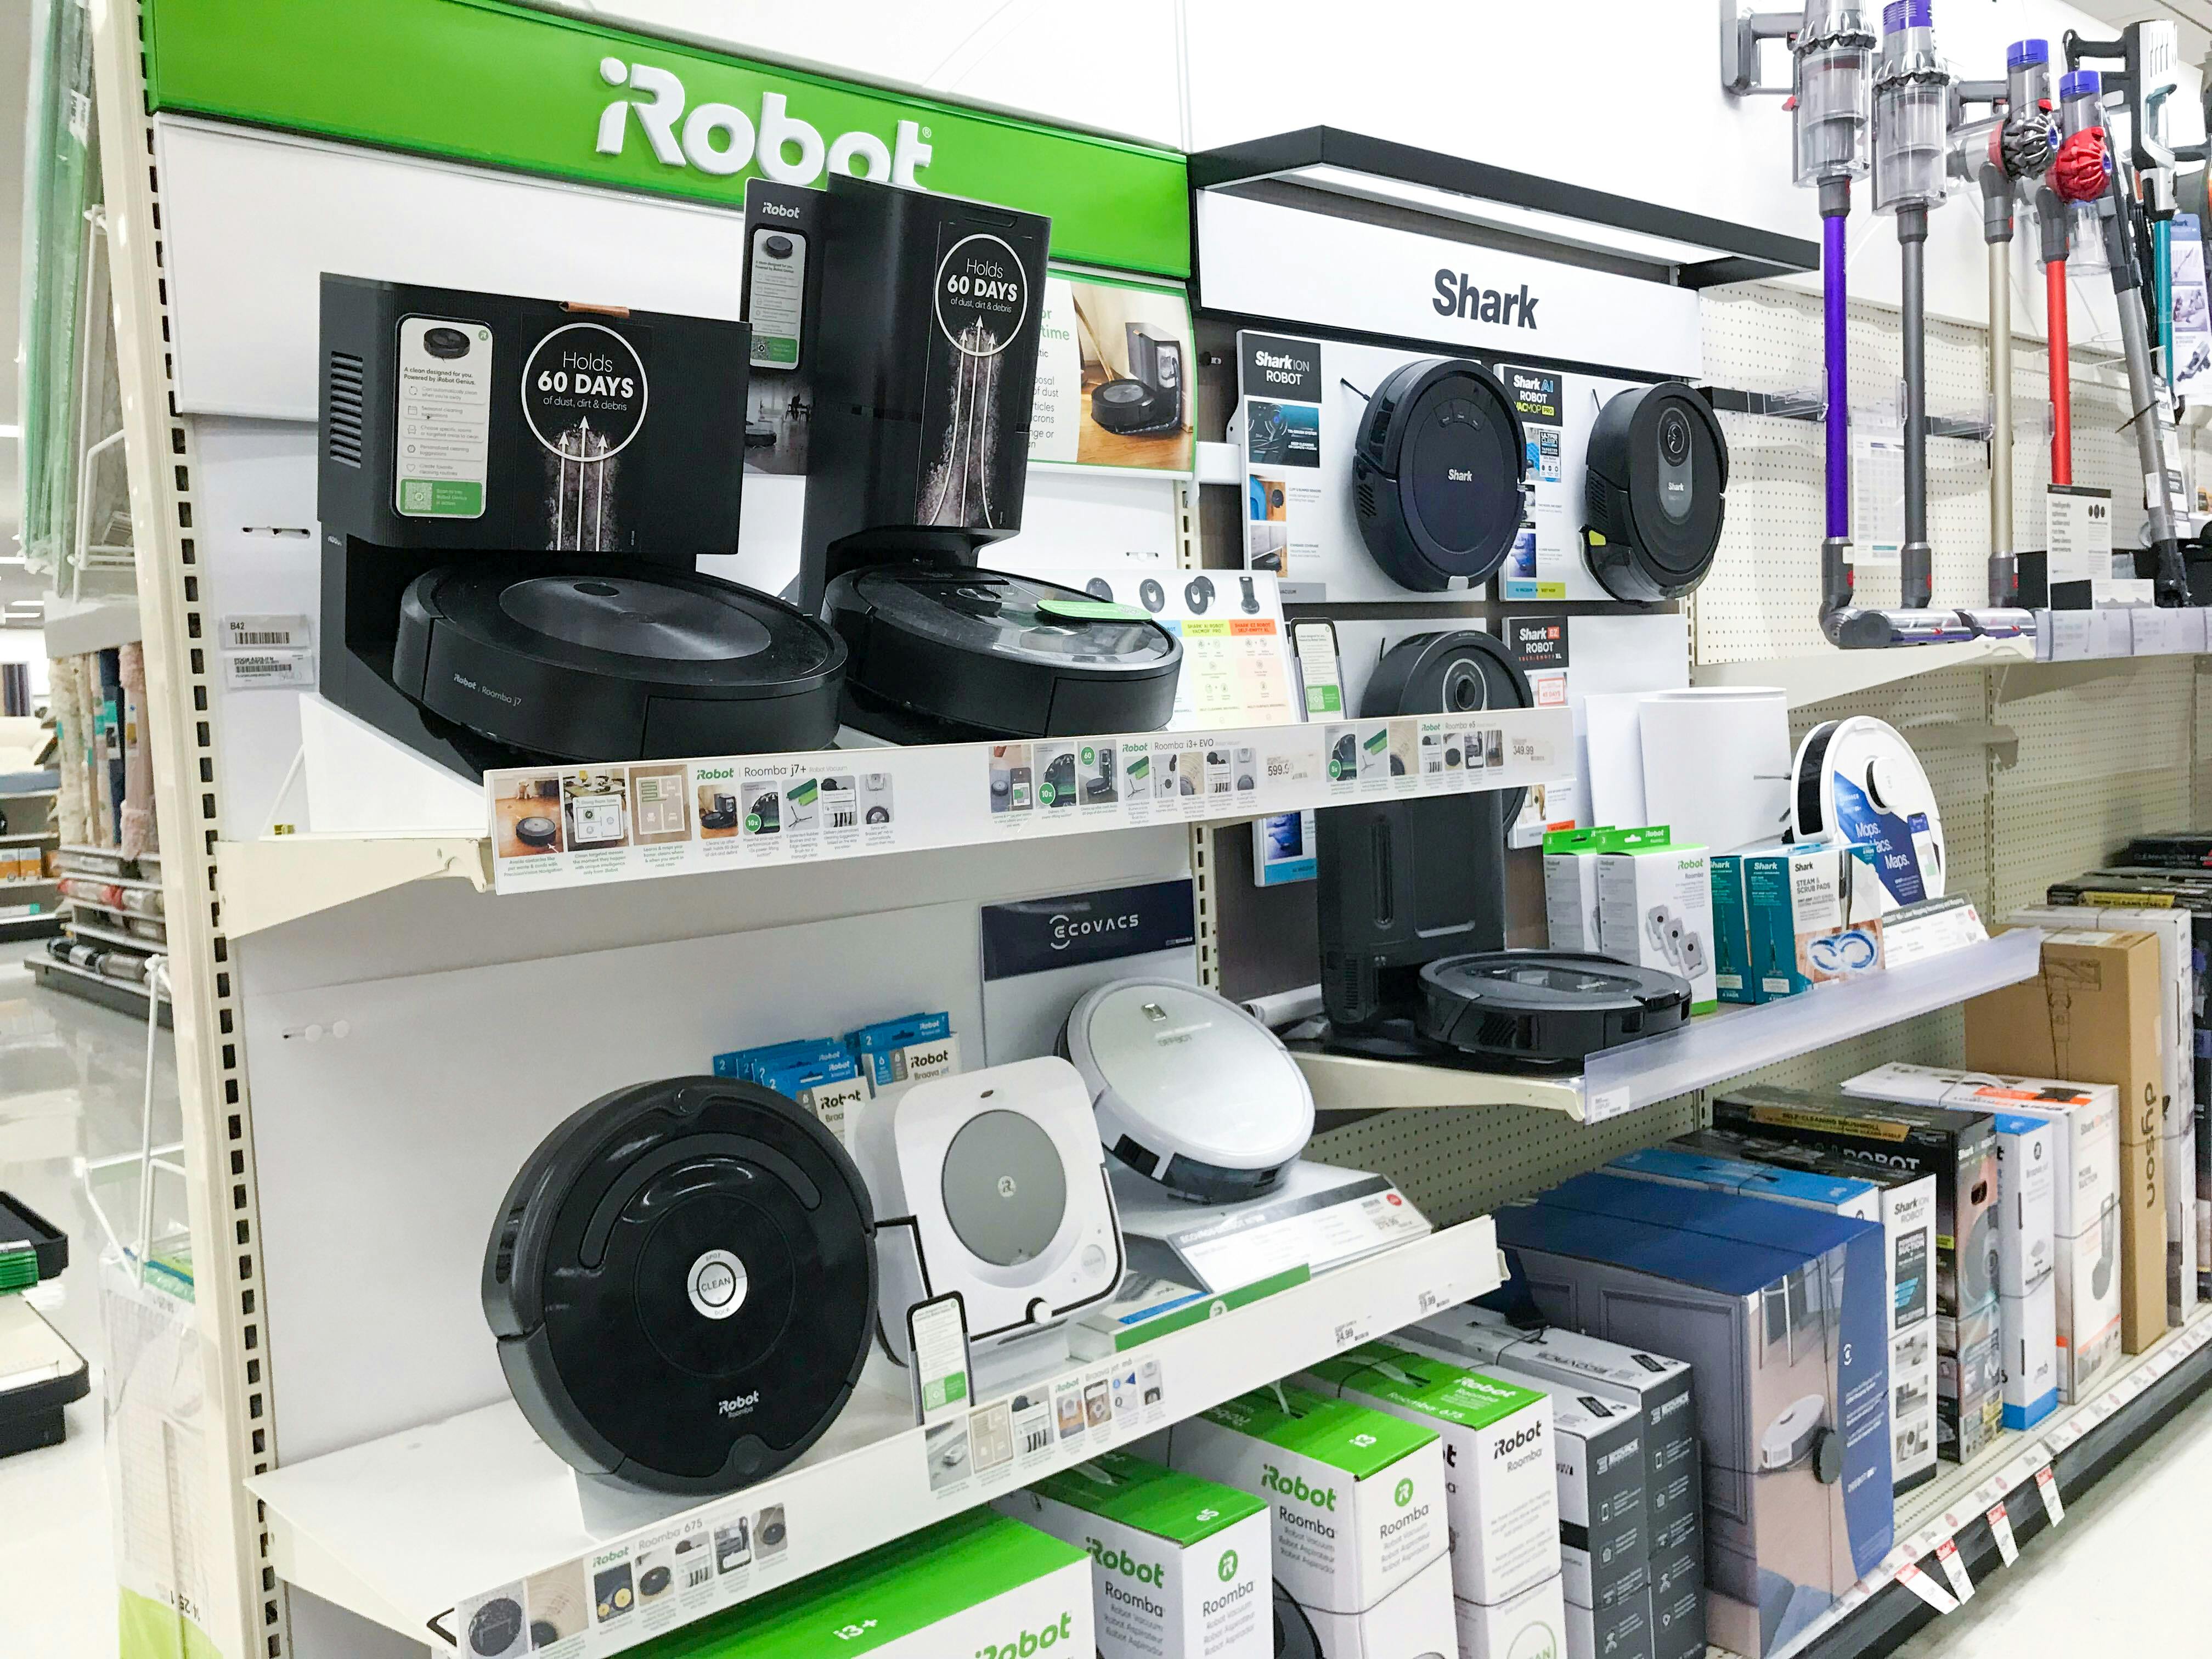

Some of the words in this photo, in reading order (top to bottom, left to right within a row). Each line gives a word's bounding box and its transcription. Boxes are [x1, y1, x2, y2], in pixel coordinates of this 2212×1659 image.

[596, 57, 932, 189] iRobot
[763, 202, 800, 219] iRobot
[967, 258, 1003, 278] Holds
[947, 274, 969, 295] 60
[974, 278, 1018, 302] DAYS
[958, 298, 974, 308] dust,
[975, 301, 986, 309] dirt
[986, 302, 991, 310] &
[992, 303, 1012, 313] debris
[1432, 269, 1539, 329] Shark
[1041, 325, 1070, 340] time
[563, 351, 613, 373] Holds
[1255, 351, 1293, 370] Shark
[1293, 360, 1310, 372] ION
[538, 370, 568, 392] 60
[575, 373, 634, 398] DAYS
[1266, 370, 1302, 385] ROBOT
[1514, 375, 1541, 391] Shark
[1541, 379, 1554, 392] AI
[1042, 387, 1059, 397] dust
[1520, 391, 1547, 404] ROBOT
[543, 396, 553, 405] of
[554, 397, 575, 408] dust,
[577, 399, 591, 408] dirt
[592, 399, 599, 409] &
[601, 400, 627, 411] debris
[1046, 431, 1054, 439] or
[1448, 469, 1472, 482] Shark
[1668, 482, 1684, 492] Shark
[230, 622, 245, 630] B42
[1519, 627, 1547, 641] Shark
[1526, 641, 1554, 653] ROBOT
[454, 673, 477, 690] iRobot
[482, 686, 512, 703] Roomba
[513, 697, 522, 707] j7
[1421, 723, 1441, 731] iRobot
[1445, 721, 1468, 730] Roomba
[1122, 742, 1148, 753] iRobot
[1154, 741, 1184, 751] Roomba
[1186, 740, 1198, 748] i3+
[1199, 738, 1214, 747] EVO
[1513, 746, 1534, 755] 349.99
[1084, 751, 1092, 759] 60
[696, 768, 734, 780] iRobot
[744, 765, 787, 777] Roomba
[790, 764, 806, 777] j7+
[1041, 789, 1053, 798] 10x
[1855, 822, 1881, 838] Mops.
[1678, 858, 1703, 870] iRobot
[1754, 862, 1778, 870] Shark
[1795, 862, 1813, 872] Shark
[1884, 854, 1910, 870] Maps.
[1796, 878, 1815, 887] STEAM
[1797, 884, 1815, 894] SCRUB
[1817, 882, 1831, 890] PADS
[1054, 914, 1139, 939] ECOVACS
[919, 1020, 939, 1030] iRobot
[866, 1036, 872, 1046] 2
[819, 1051, 840, 1062] iRobot
[911, 1050, 949, 1069] iRobot
[719, 1060, 726, 1070] 2
[828, 1060, 850, 1071] iRobot
[914, 1069, 939, 1080] Braava
[825, 1112, 844, 1122] Braa
[2141, 1082, 2157, 1209] dyson
[1894, 1198, 1918, 1215] Shark
[701, 1277, 731, 1293] CLEAN
[1453, 1376, 1517, 1397] iRobot
[719, 1390, 759, 1415] iRobot
[1493, 1420, 1542, 1460] iRobot
[1507, 1448, 1542, 1472] Roomba
[1261, 1463, 1337, 1512] iRobot
[1279, 1505, 1335, 1539] Roomba
[1380, 1504, 1429, 1539] Roomba
[592, 1546, 629, 1568] iRobot
[639, 1527, 681, 1551] Roomba
[684, 1518, 703, 1534] 675
[1086, 1536, 1165, 1589] iRobot
[1105, 1581, 1164, 1618] Roomba
[1203, 1581, 1254, 1617] Roomba
[833, 1618, 878, 1641] i3+
[975, 1611, 1071, 1658] Robot
